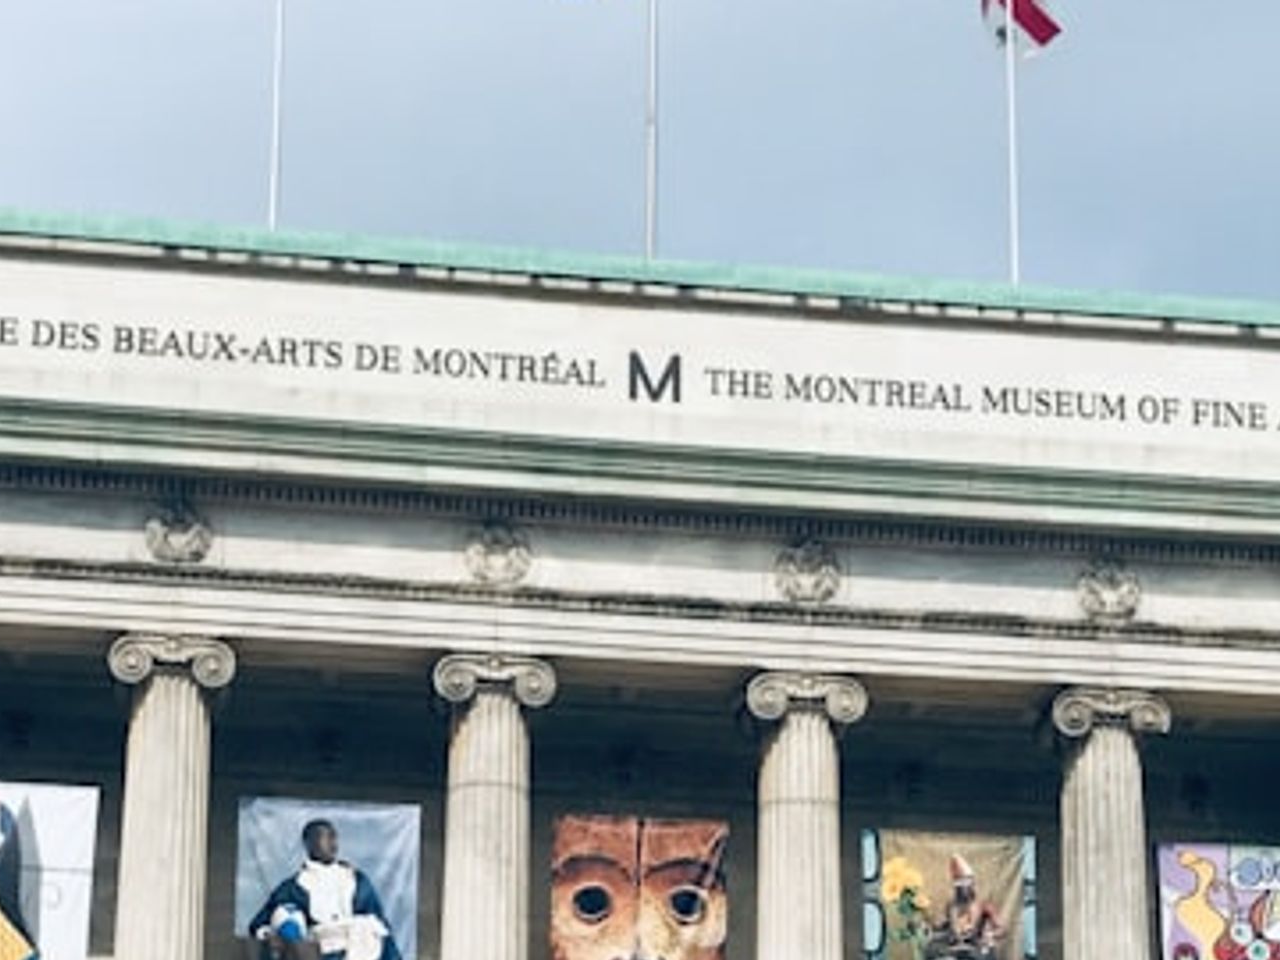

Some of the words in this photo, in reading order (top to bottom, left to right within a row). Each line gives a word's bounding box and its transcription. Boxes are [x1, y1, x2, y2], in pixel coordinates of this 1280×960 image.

[30, 319, 101, 351] DES
[112, 325, 344, 369] BEAUX-ARTS
[355, 343, 403, 374] DE
[413, 346, 607, 387] MONTRÉAL
[628, 350, 683, 404] M
[703, 367, 773, 400] THE
[783, 373, 973, 412] MONTREAL
[981, 386, 1127, 422] MUSEUM
[1136, 397, 1181, 426] OF
[1192, 400, 1268, 431] FINE
